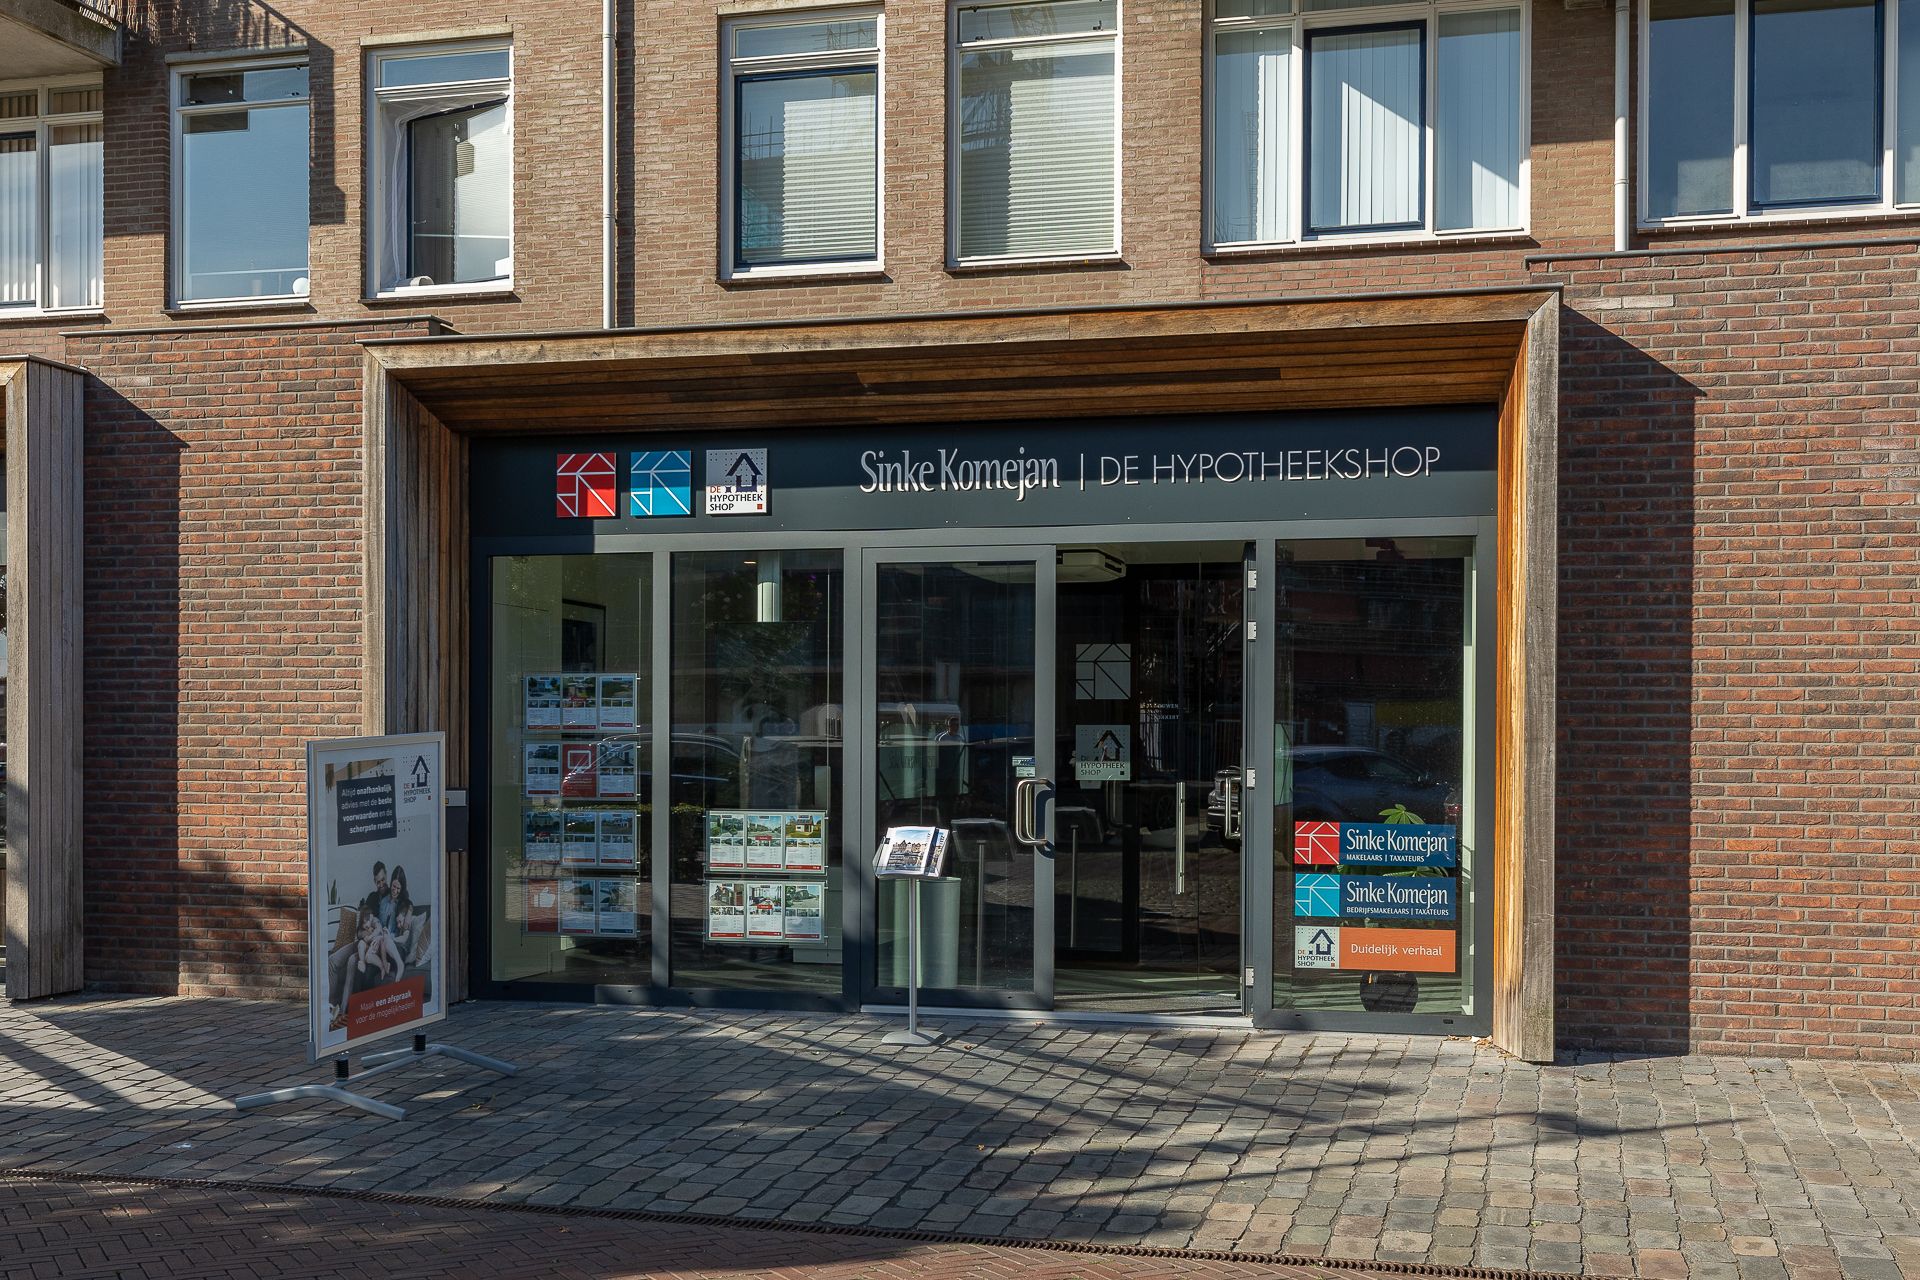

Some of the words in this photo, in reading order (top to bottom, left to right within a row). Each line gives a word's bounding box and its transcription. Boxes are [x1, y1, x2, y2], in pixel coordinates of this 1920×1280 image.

[860, 450, 936, 492] Sinke
[938, 447, 1061, 502] Komejan
[1101, 455, 1140, 486] DE
[1153, 446, 1441, 484] HYPOTHEEKSHOP
[710, 494, 763, 502] HYPOTHEEK
[710, 503, 734, 512] SHOP
[342, 788, 356, 798] Altijd
[356, 784, 392, 795] onafhankelijk
[404, 788, 432, 796] HYPOTHEEK
[341, 801, 358, 810] advies
[342, 810, 378, 822] voorwaarden
[350, 824, 376, 834] scherpste
[1346, 828, 1384, 850] Sinke
[1386, 830, 1448, 857] Komejan
[1346, 880, 1385, 903] Sinke
[1387, 882, 1448, 909] Komejan
[1346, 906, 1410, 914] BEDRIJFSMAKELAARS
[1351, 944, 1398, 956] Duidelijk
[1402, 945, 1442, 956] verhaal
[360, 1001, 375, 1010] Maak
[376, 999, 387, 1007] een
[388, 990, 412, 1004] afspraak
[356, 1015, 368, 1024] voor
[368, 1012, 376, 1021] de
